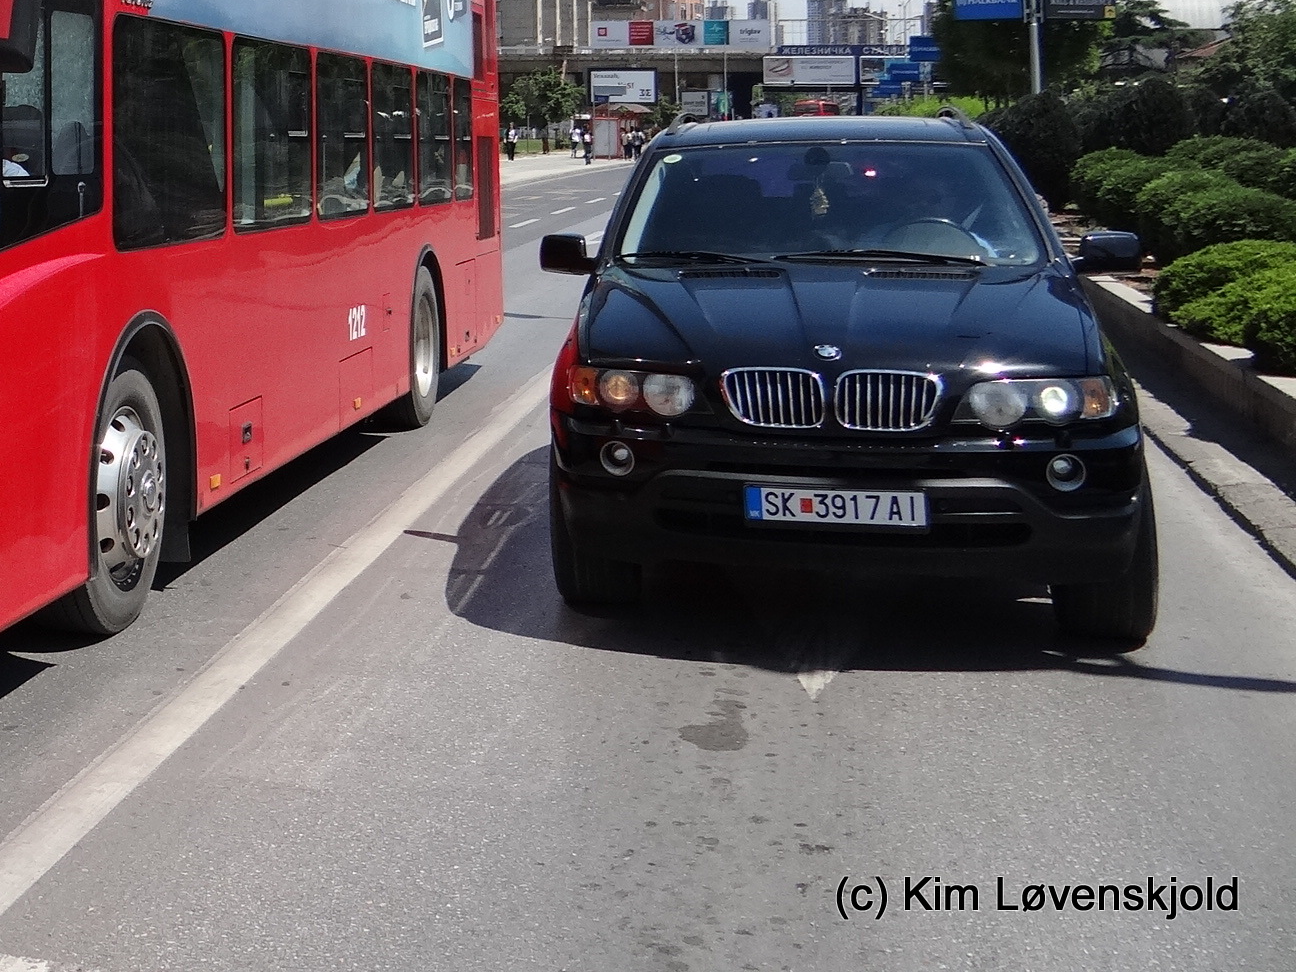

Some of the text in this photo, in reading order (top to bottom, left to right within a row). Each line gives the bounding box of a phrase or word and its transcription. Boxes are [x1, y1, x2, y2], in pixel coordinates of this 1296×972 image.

[782, 46, 852, 55] ЖЕЛЕЗНИЧКА
[348, 304, 366, 341] 1212
[764, 491, 796, 517] SK
